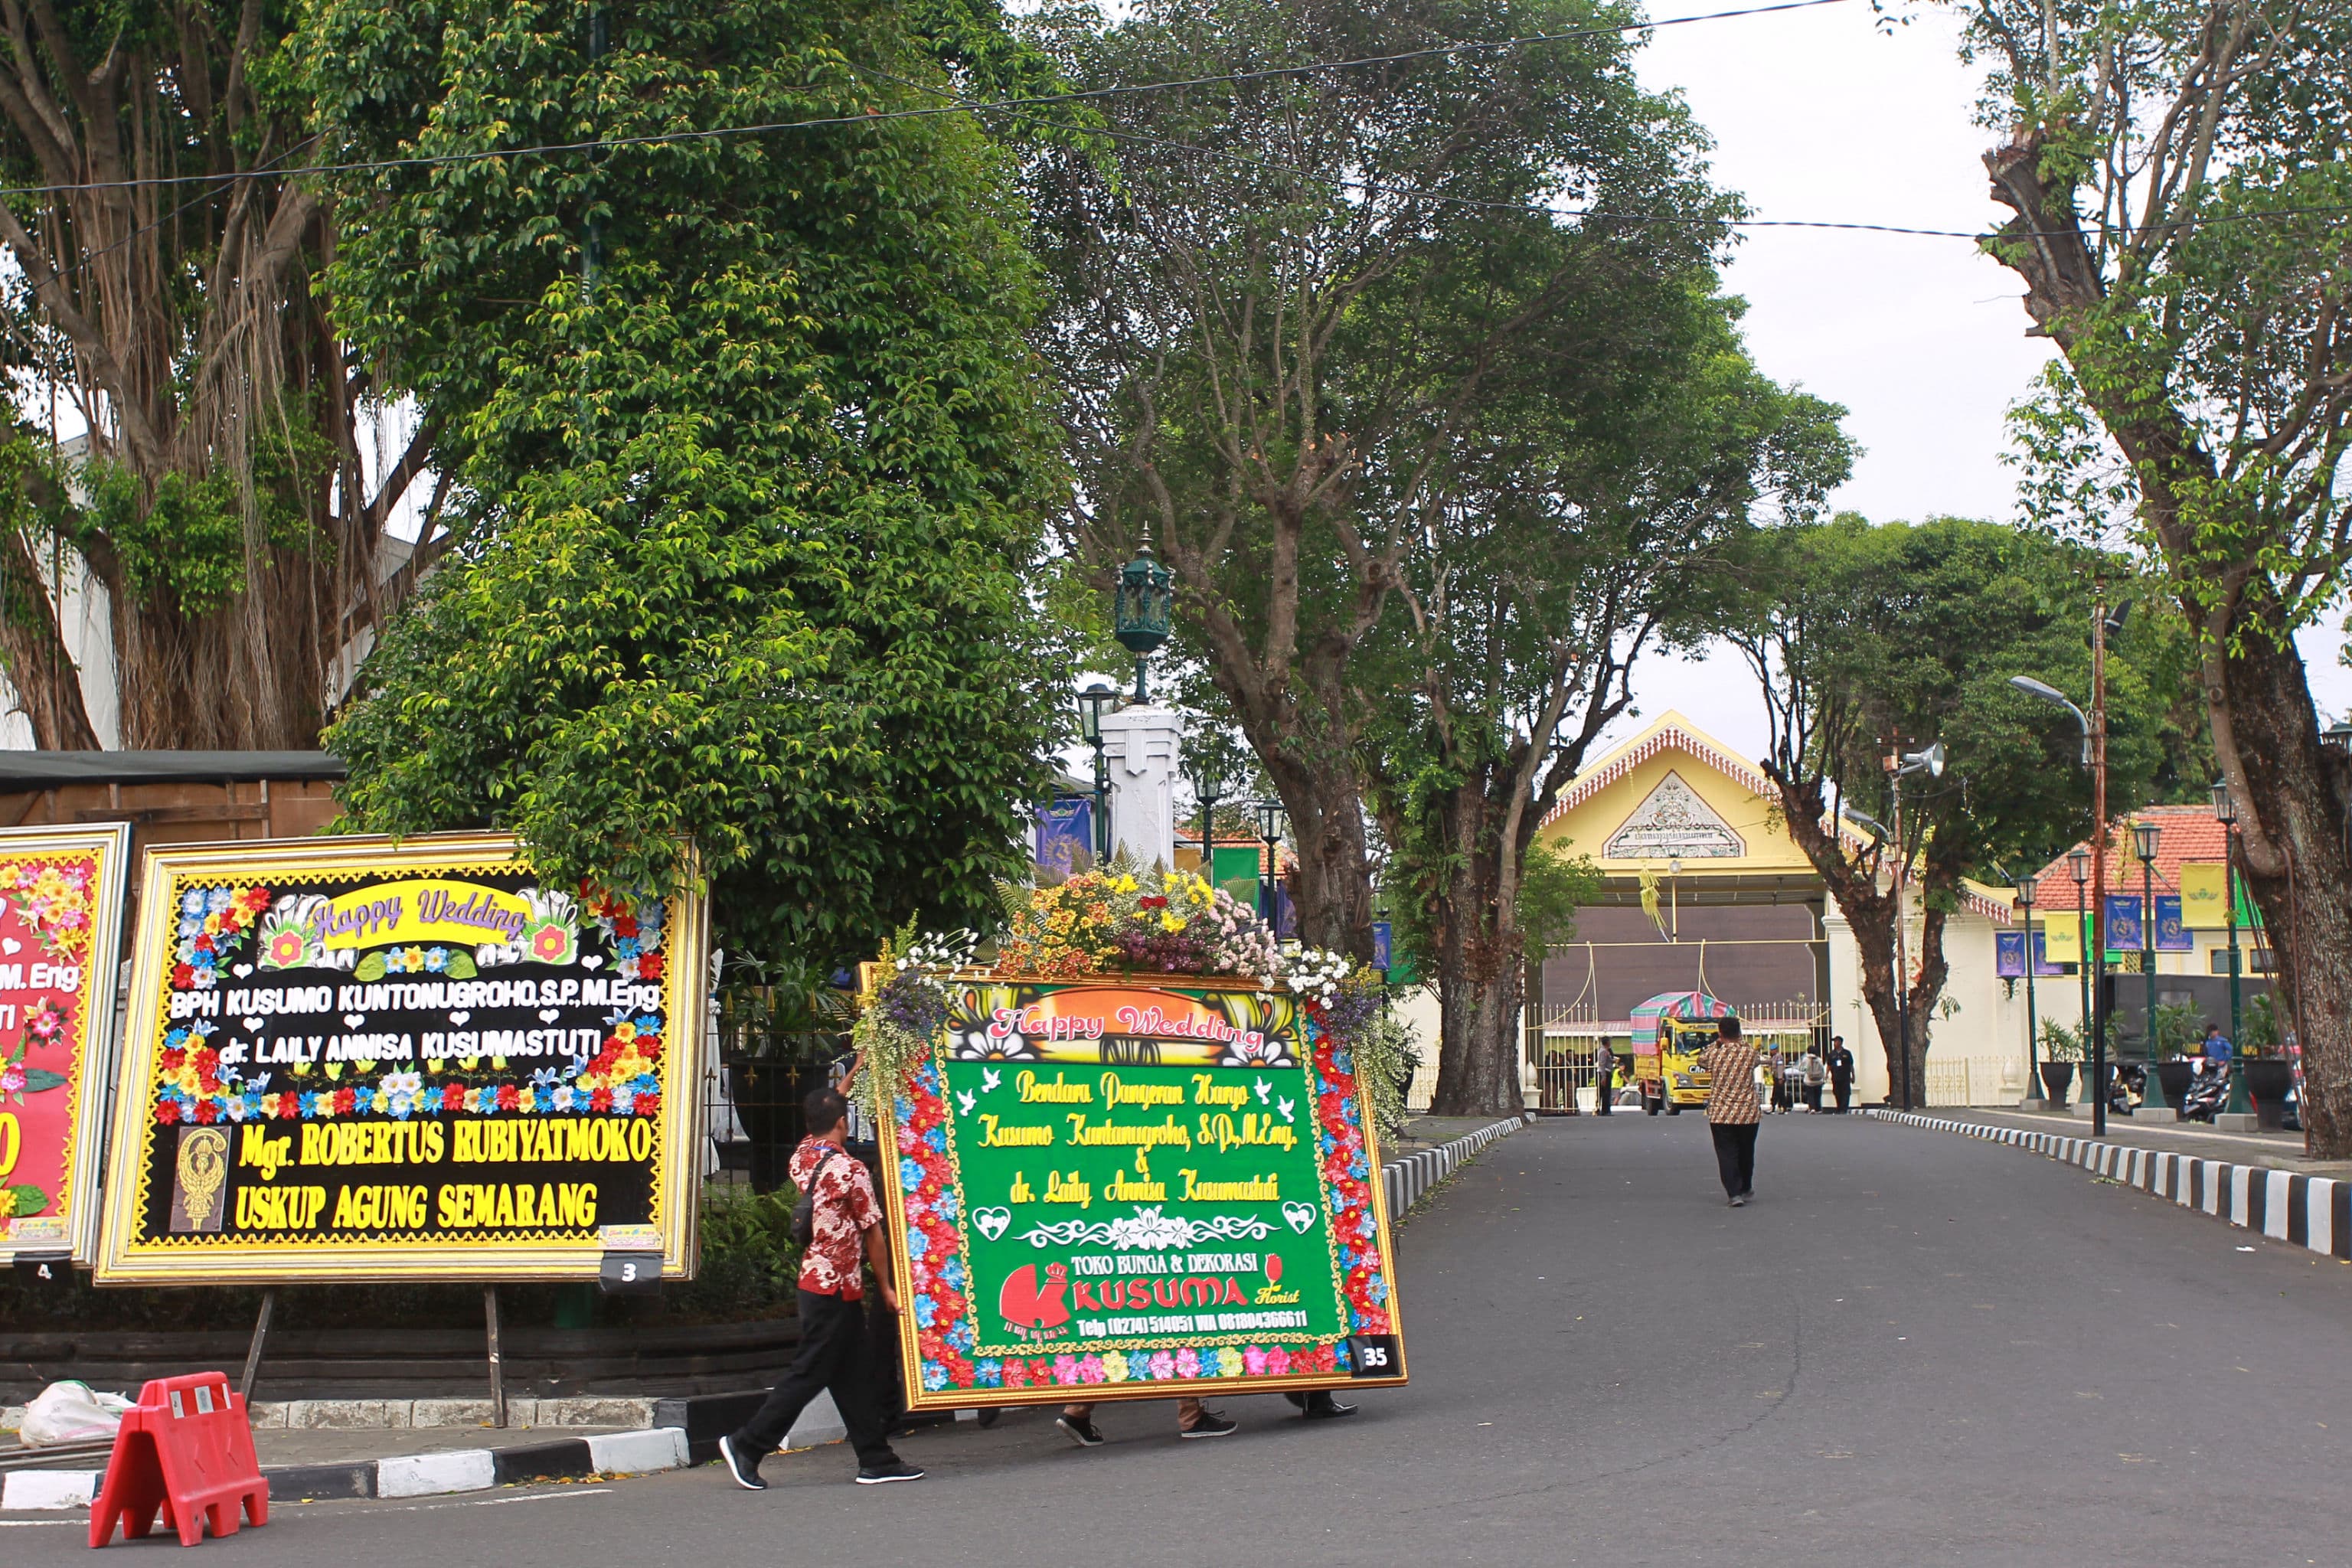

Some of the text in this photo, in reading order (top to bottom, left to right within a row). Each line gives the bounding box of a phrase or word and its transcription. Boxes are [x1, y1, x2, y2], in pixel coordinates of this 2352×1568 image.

[312, 889, 527, 942] Happy Wedding
[170, 990, 220, 1019] BPH
[226, 985, 332, 1016] KUSUMO
[987, 1005, 1263, 1053] Happy Wedding
[219, 1029, 602, 1064] dr. LAILY ANNISA KUSUMASTUTI
[1016, 1070, 1250, 1112] Bendara Pangeran Haryo
[978, 1114, 1055, 1147] Kusumo
[239, 1118, 652, 1181] Mgr. ROBERTUS RUBIYATMOKO
[1135, 1147, 1149, 1173] &
[1010, 1168, 1281, 1209] dr. Laily Annisa Kusumastuti
[236, 1183, 597, 1229] USKUP AGUNG SEMARANG
[38, 1264, 52, 1279] 4
[622, 1263, 637, 1282] 3
[1070, 1253, 1259, 1276] TOKO BUNGA & DEKORASI
[1072, 1276, 1300, 1312] KUSUMA Florist
[1076, 1318, 1106, 1338] Telp
[1107, 1317, 1148, 1335] (0274)
[1148, 1315, 1194, 1333] 514051
[1194, 1314, 1217, 1331] WA
[1217, 1310, 1308, 1331] 081804366611
[1364, 1348, 1387, 1366] 35
